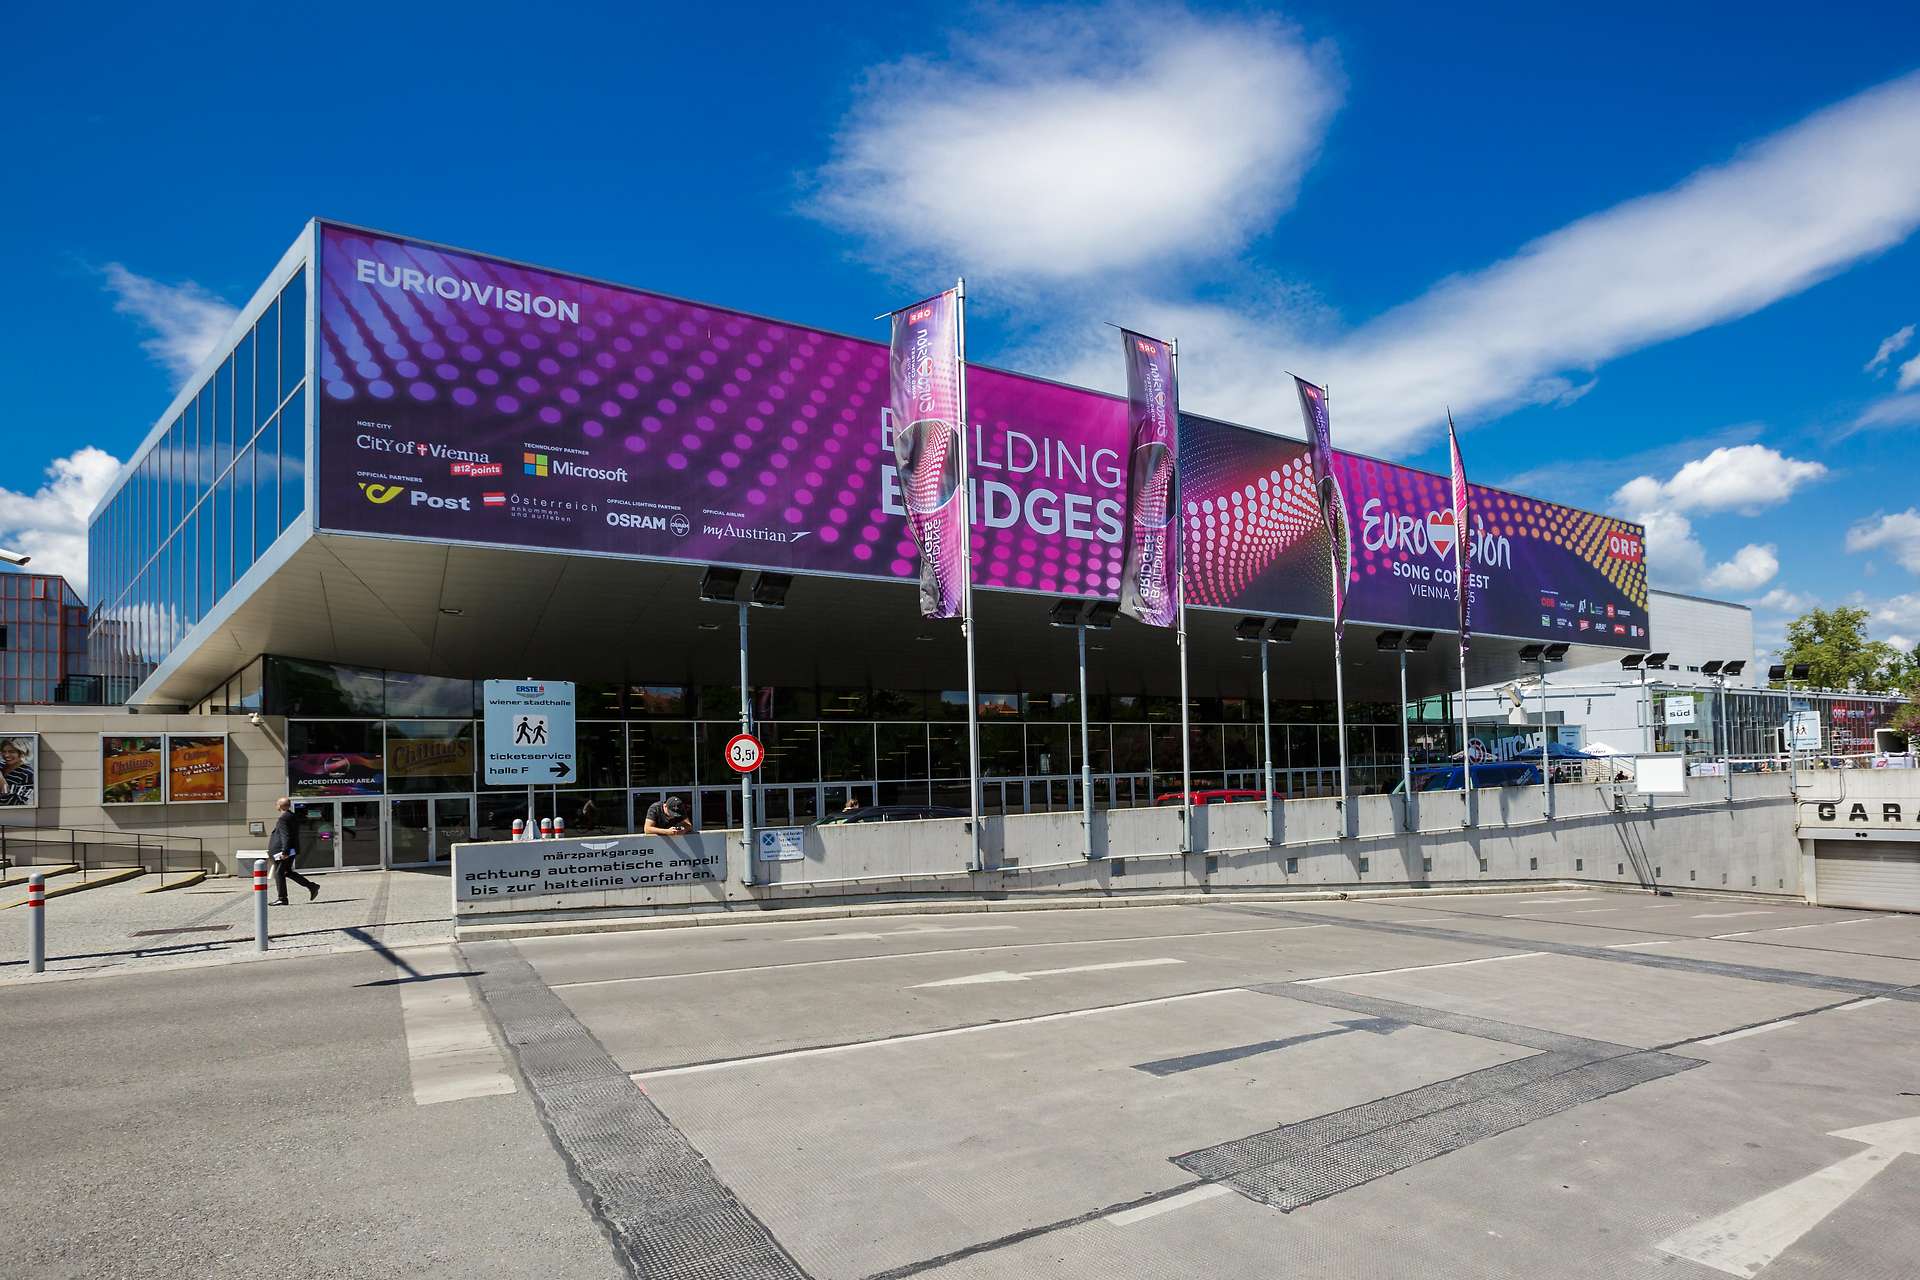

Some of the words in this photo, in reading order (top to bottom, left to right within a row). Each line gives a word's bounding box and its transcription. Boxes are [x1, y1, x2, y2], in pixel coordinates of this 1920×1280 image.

[395, 441, 416, 454] of
[428, 443, 490, 463] Vienna
[524, 442, 563, 452] TECHNOLOGY
[563, 447, 590, 456] PARTNER
[356, 471, 388, 480] OFFICIAL
[389, 474, 423, 483] PARTNERS
[552, 460, 628, 482] Microsoft
[410, 490, 471, 511] Post
[511, 493, 598, 512] Österreich
[606, 498, 632, 506] OFFICIAL
[881, 464, 1124, 543] BIDGES
[606, 512, 666, 531] OSRAM
[1610, 536, 1638, 558] ORF
[1393, 561, 1430, 581] SONG
[1409, 583, 1450, 600] VIENNA
[516, 685, 538, 693] ERSTE
[1669, 709, 1691, 718] süd
[490, 752, 572, 760] ticketservice
[489, 767, 518, 775] halle
[297, 778, 355, 786] ACCREDITATION
[356, 777, 376, 785] AREA
[1818, 802, 1920, 823] GAR
[543, 847, 655, 861] märzparkgarage
[465, 868, 541, 881] achtung
[548, 859, 664, 876] automatische
[669, 855, 719, 868] ampel!
[471, 885, 499, 896] bis
[506, 883, 536, 893] zur
[544, 875, 624, 890] haltelinie
[631, 870, 715, 884] vorfahren.
